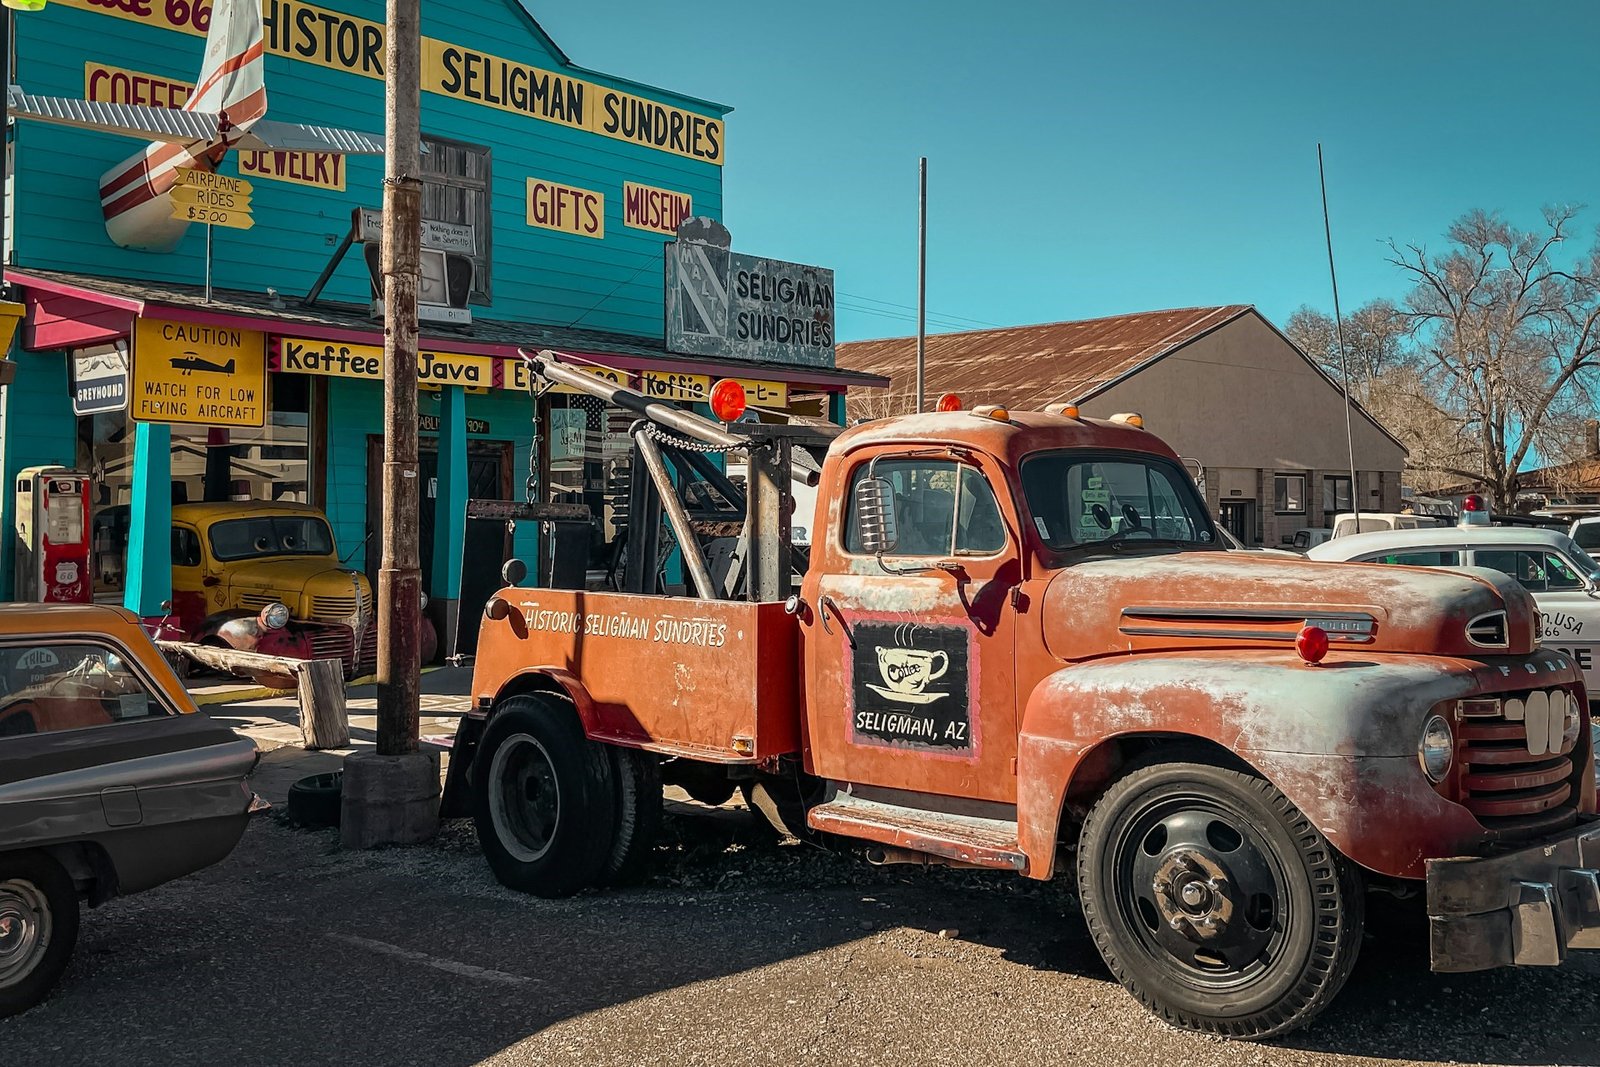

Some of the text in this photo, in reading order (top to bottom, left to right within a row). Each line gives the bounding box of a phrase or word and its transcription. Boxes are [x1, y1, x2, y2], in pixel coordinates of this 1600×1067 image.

[441, 48, 583, 125] SELIGMAN
[603, 93, 719, 159] SUNDRIES
[186, 171, 240, 193] AIRPLANE
[243, 149, 341, 186] JEWELRY
[197, 190, 234, 208] RIDES
[532, 182, 598, 234] GIFTS
[626, 185, 691, 230] MUSEUM
[187, 206, 228, 222] $5.00
[737, 270, 834, 309] SELIGMAN
[161, 324, 240, 348] CAUTION
[737, 312, 832, 348] SUNDRIES
[286, 341, 380, 375] Kaffee
[418, 353, 479, 382] Java
[78, 382, 123, 403] GREYHOUND
[145, 381, 254, 402] WATCH FOR LOW
[646, 372, 703, 398] Koffie
[141, 400, 256, 420] FLYING AIRCRAFT
[59, 571, 74, 580] 66
[524, 608, 727, 648] HISTORIC SELIGMAN SUNDRIES
[856, 711, 967, 741] SELIGMAN, AZ
